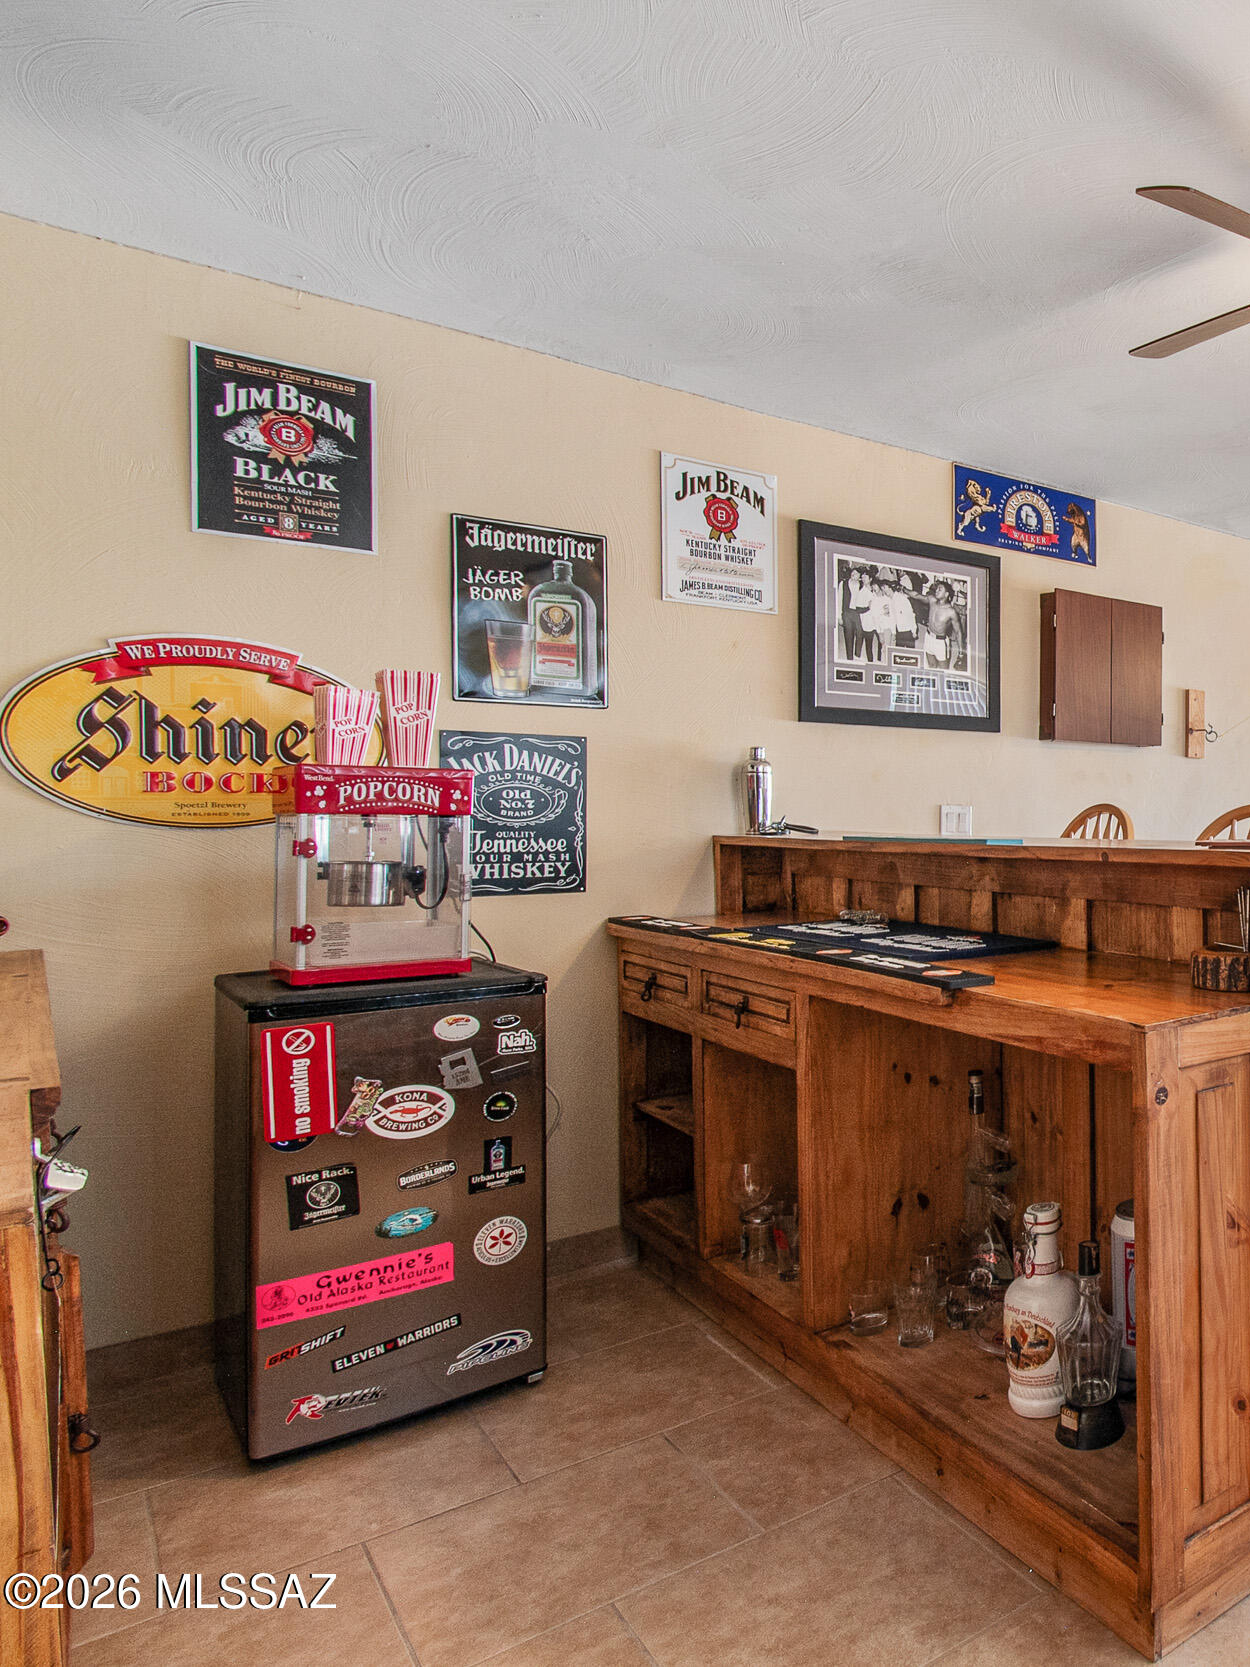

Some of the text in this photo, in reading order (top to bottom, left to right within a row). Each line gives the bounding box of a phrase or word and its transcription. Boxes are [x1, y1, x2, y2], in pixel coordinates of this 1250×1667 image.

[214, 358, 356, 393] THE WORLD'S FINEST BOURBON
[214, 382, 274, 418] JIM
[276, 382, 357, 443] BEAM
[280, 428, 296, 442] B
[232, 456, 340, 493] BLACK
[233, 486, 341, 510] Kentucky Straight
[263, 483, 312, 497] SOUR MASH
[674, 471, 712, 501] JIM
[715, 470, 766, 517] BEAM
[234, 496, 340, 520] Bourbon Whiskey
[717, 509, 726, 521] B
[1006, 491, 1053, 530] FIRESTONE
[242, 514, 338, 532] AGED 8 YEARS
[1012, 530, 1047, 544] WALKER
[685, 538, 757, 558] KENTUCKY STRAIGHT
[689, 548, 754, 566] BOURBON WHISKEY
[462, 565, 525, 587] JÄGER
[469, 586, 524, 602] BOMB
[680, 579, 701, 593] JAMES
[707, 582, 724, 591] BEAM
[724, 585, 754, 599] DISTILLING
[124, 643, 291, 671] WE PROUDLY SERVE
[394, 702, 414, 715] POP
[334, 718, 353, 728] POP
[400, 710, 429, 726] CORN
[338, 725, 366, 738] CORN
[503, 743, 582, 788] DANIEL'S
[488, 772, 543, 783] OLD TIME
[338, 782, 441, 808] POPCORN
[502, 789, 531, 799] Old
[210, 801, 248, 810] Brewery
[500, 809, 534, 817] BRAND
[470, 830, 567, 854] Tennessee
[476, 853, 570, 863] OUR MASH
[289, 1057, 312, 1135] no smoking
[394, 1092, 428, 1103] KONA
[379, 1116, 426, 1131] BREWING
[291, 1173, 319, 1186] Nice
[399, 1162, 456, 1187] BORDERLANDS
[471, 1172, 495, 1184] Urban
[315, 1252, 434, 1289] Gwennie's
[297, 1260, 450, 1306] Old Alaska Restaurant
[334, 1315, 459, 1371] ELEVEN WARRIORS
